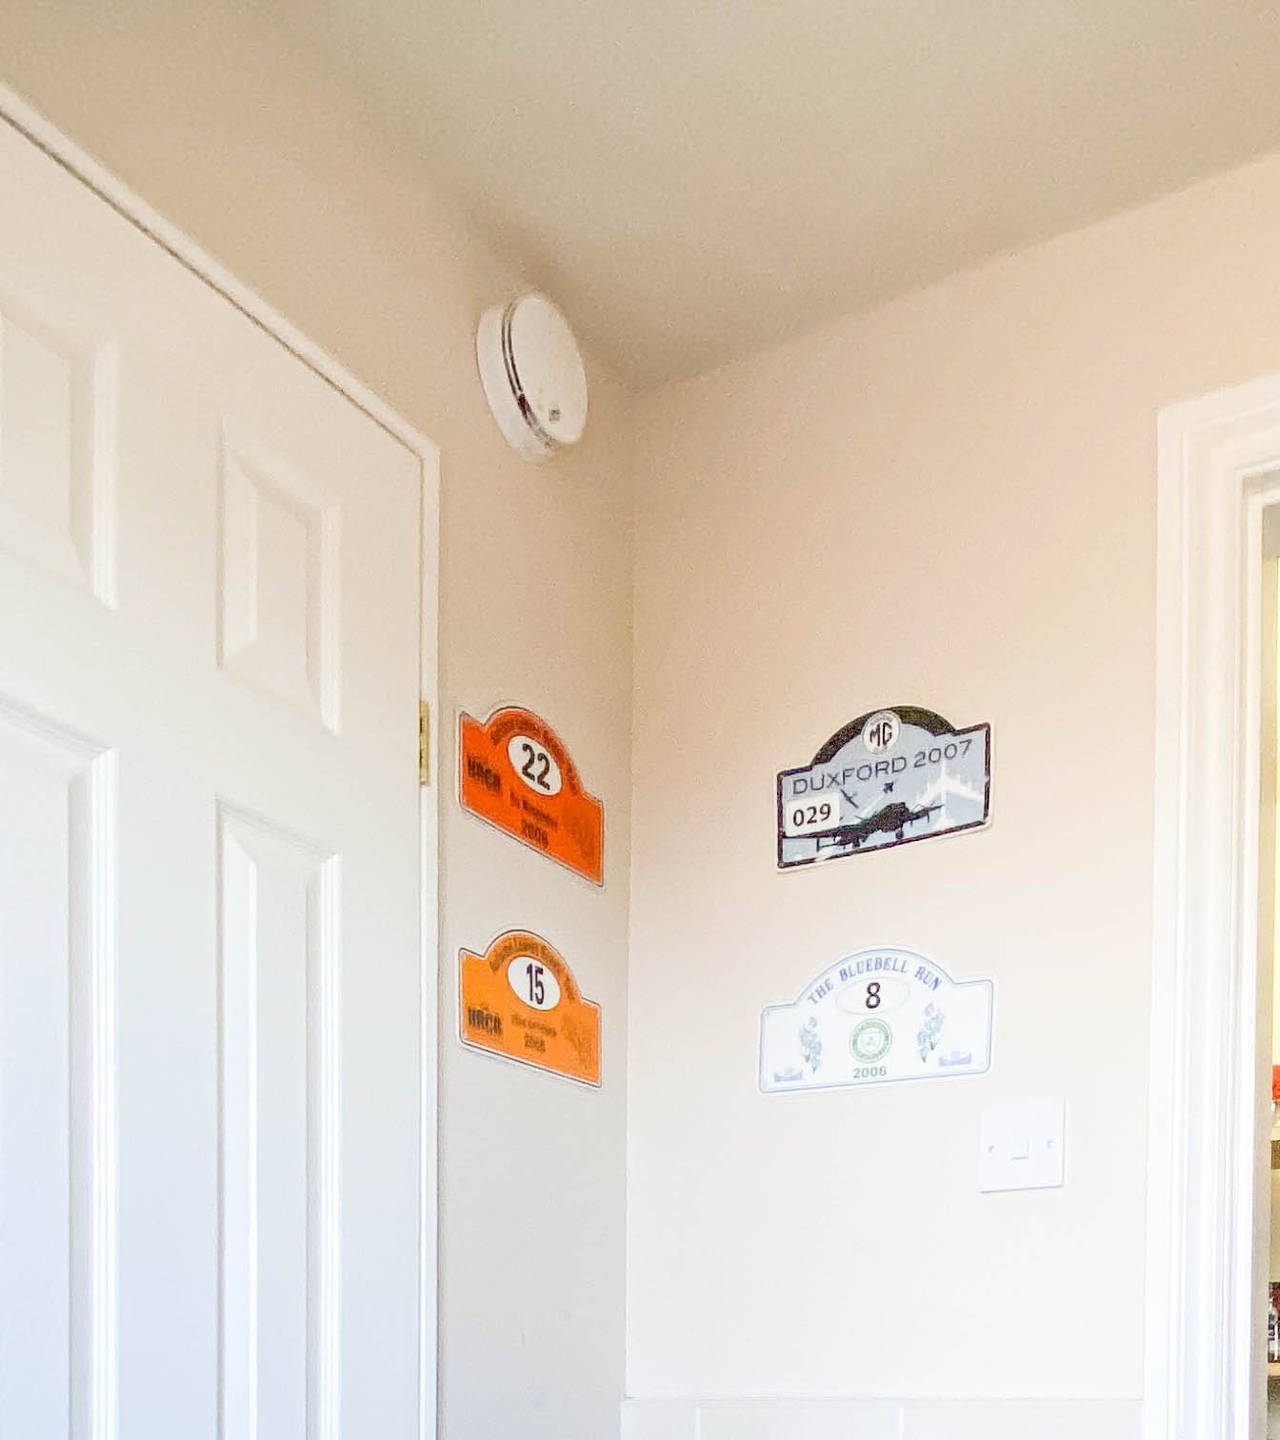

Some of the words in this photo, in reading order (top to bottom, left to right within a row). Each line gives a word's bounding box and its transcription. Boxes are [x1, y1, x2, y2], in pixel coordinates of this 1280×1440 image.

[869, 722, 893, 747] MG
[522, 743, 551, 791] 22
[792, 756, 907, 795] DUXFORD
[913, 739, 973, 769] 2007
[792, 802, 832, 828] 029
[526, 963, 544, 1005] 15
[807, 978, 835, 1005] THE
[839, 956, 909, 983] BLUEBELL
[914, 966, 943, 991] RUN
[865, 982, 881, 1009] 8
